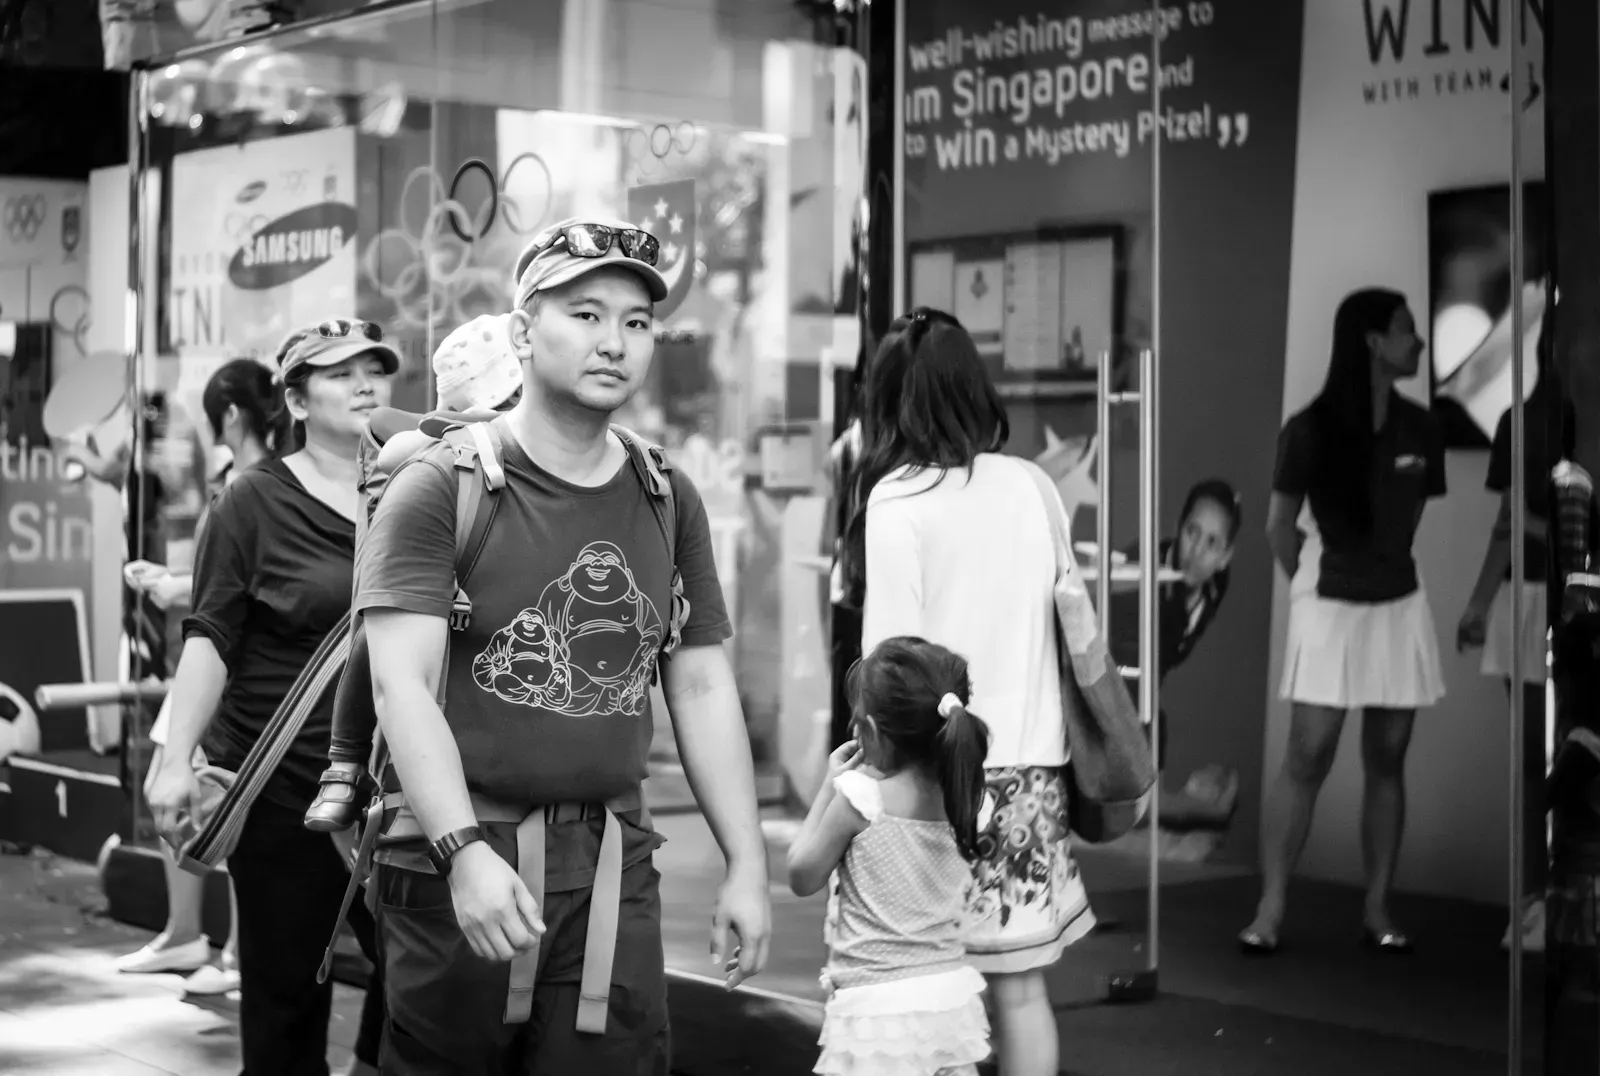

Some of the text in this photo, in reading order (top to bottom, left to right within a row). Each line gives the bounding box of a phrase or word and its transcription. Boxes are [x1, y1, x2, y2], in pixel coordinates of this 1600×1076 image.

[953, 53, 1148, 124] Singapore
[1362, 66, 1492, 105] WITH TEAM
[935, 118, 996, 170] win
[1004, 134, 1018, 161] a
[1025, 120, 1130, 166] Mystery
[242, 225, 342, 267] SAMSUNG
[8, 501, 91, 562] Sin
